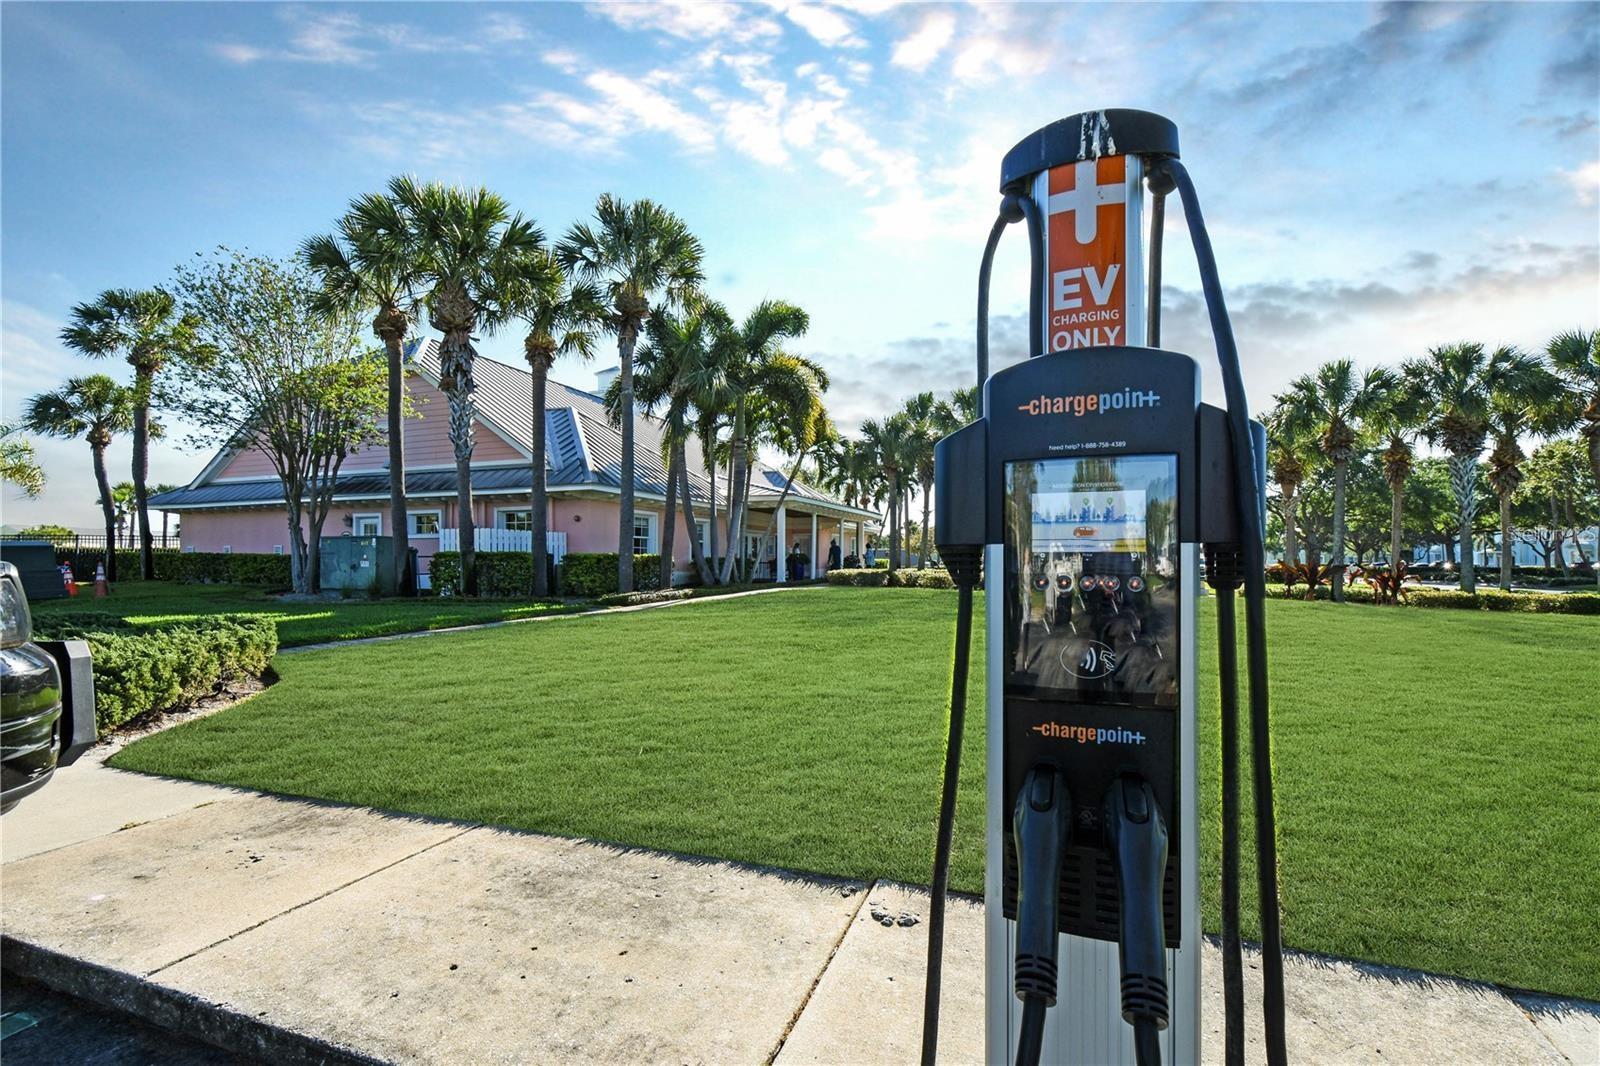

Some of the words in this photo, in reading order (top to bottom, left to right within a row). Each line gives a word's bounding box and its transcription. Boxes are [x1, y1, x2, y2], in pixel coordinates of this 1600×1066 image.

[1053, 263, 1121, 311] EV
[1052, 309, 1120, 327] CHARGING
[1052, 325, 1121, 351] ONLY
[1064, 443, 1080, 451] help?
